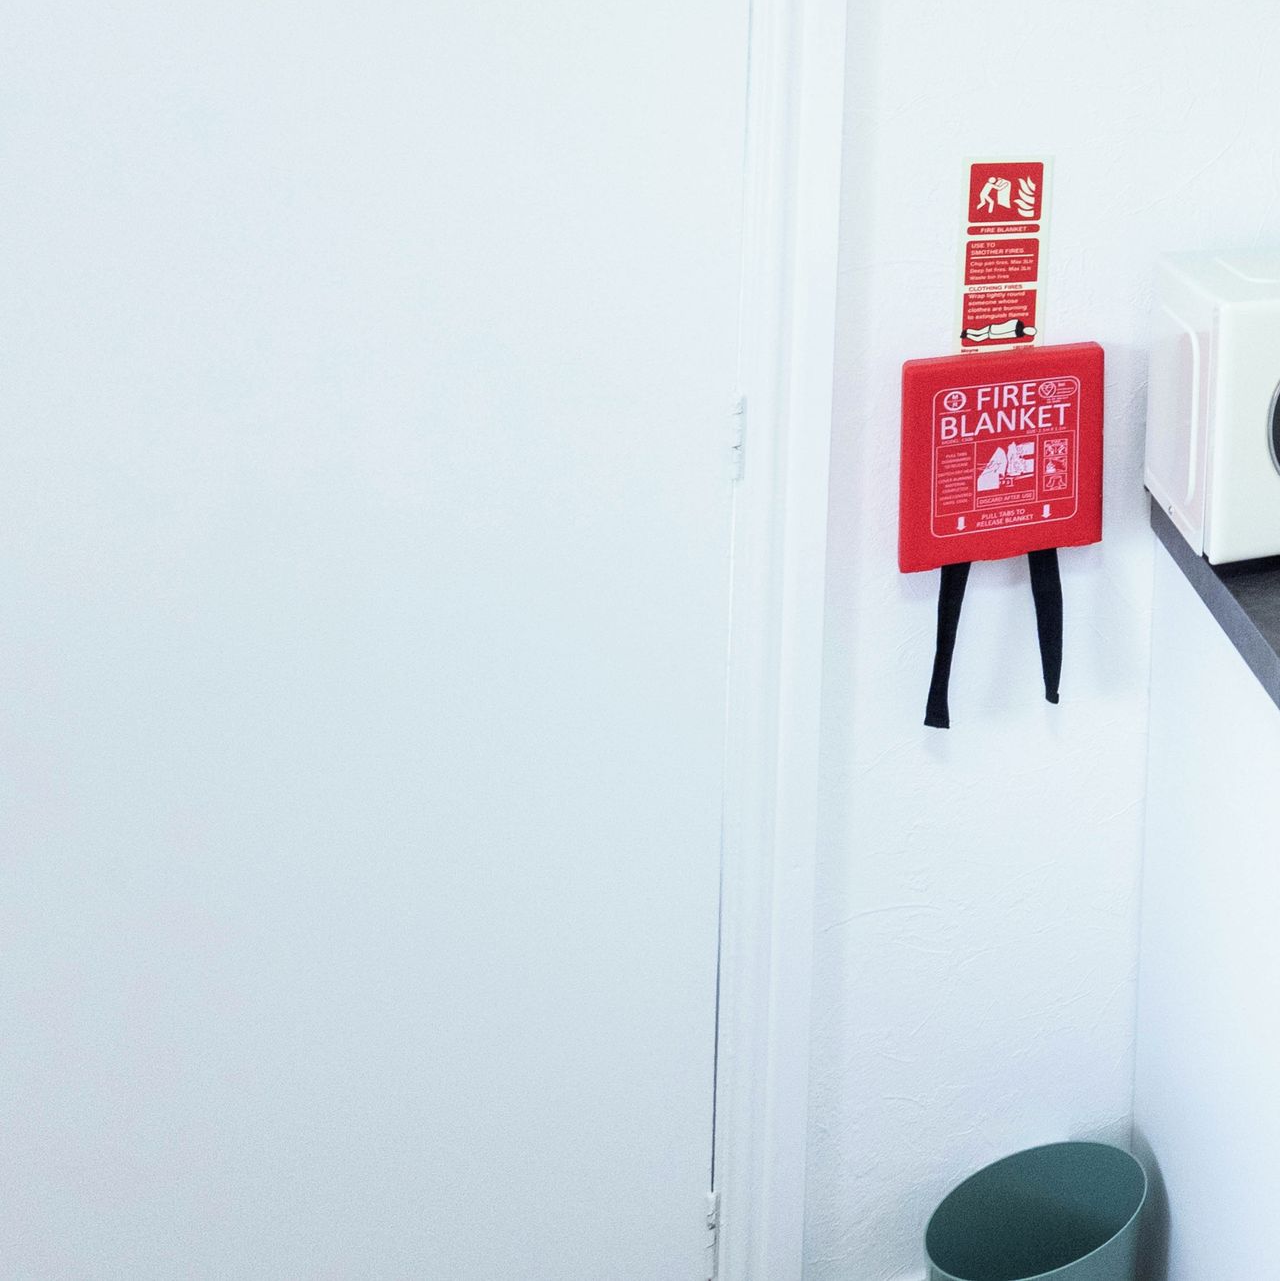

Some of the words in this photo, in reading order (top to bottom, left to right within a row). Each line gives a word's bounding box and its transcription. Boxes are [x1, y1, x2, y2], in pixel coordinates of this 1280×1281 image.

[975, 312, 1007, 320] extinguish
[977, 383, 1037, 411] FIRE
[941, 403, 1071, 440] BLANKET
[980, 496, 1003, 505] DISCARD
[981, 511, 997, 519] PULL
[976, 518, 1004, 527] RELEASE
[1005, 515, 1033, 524] BLANKET
